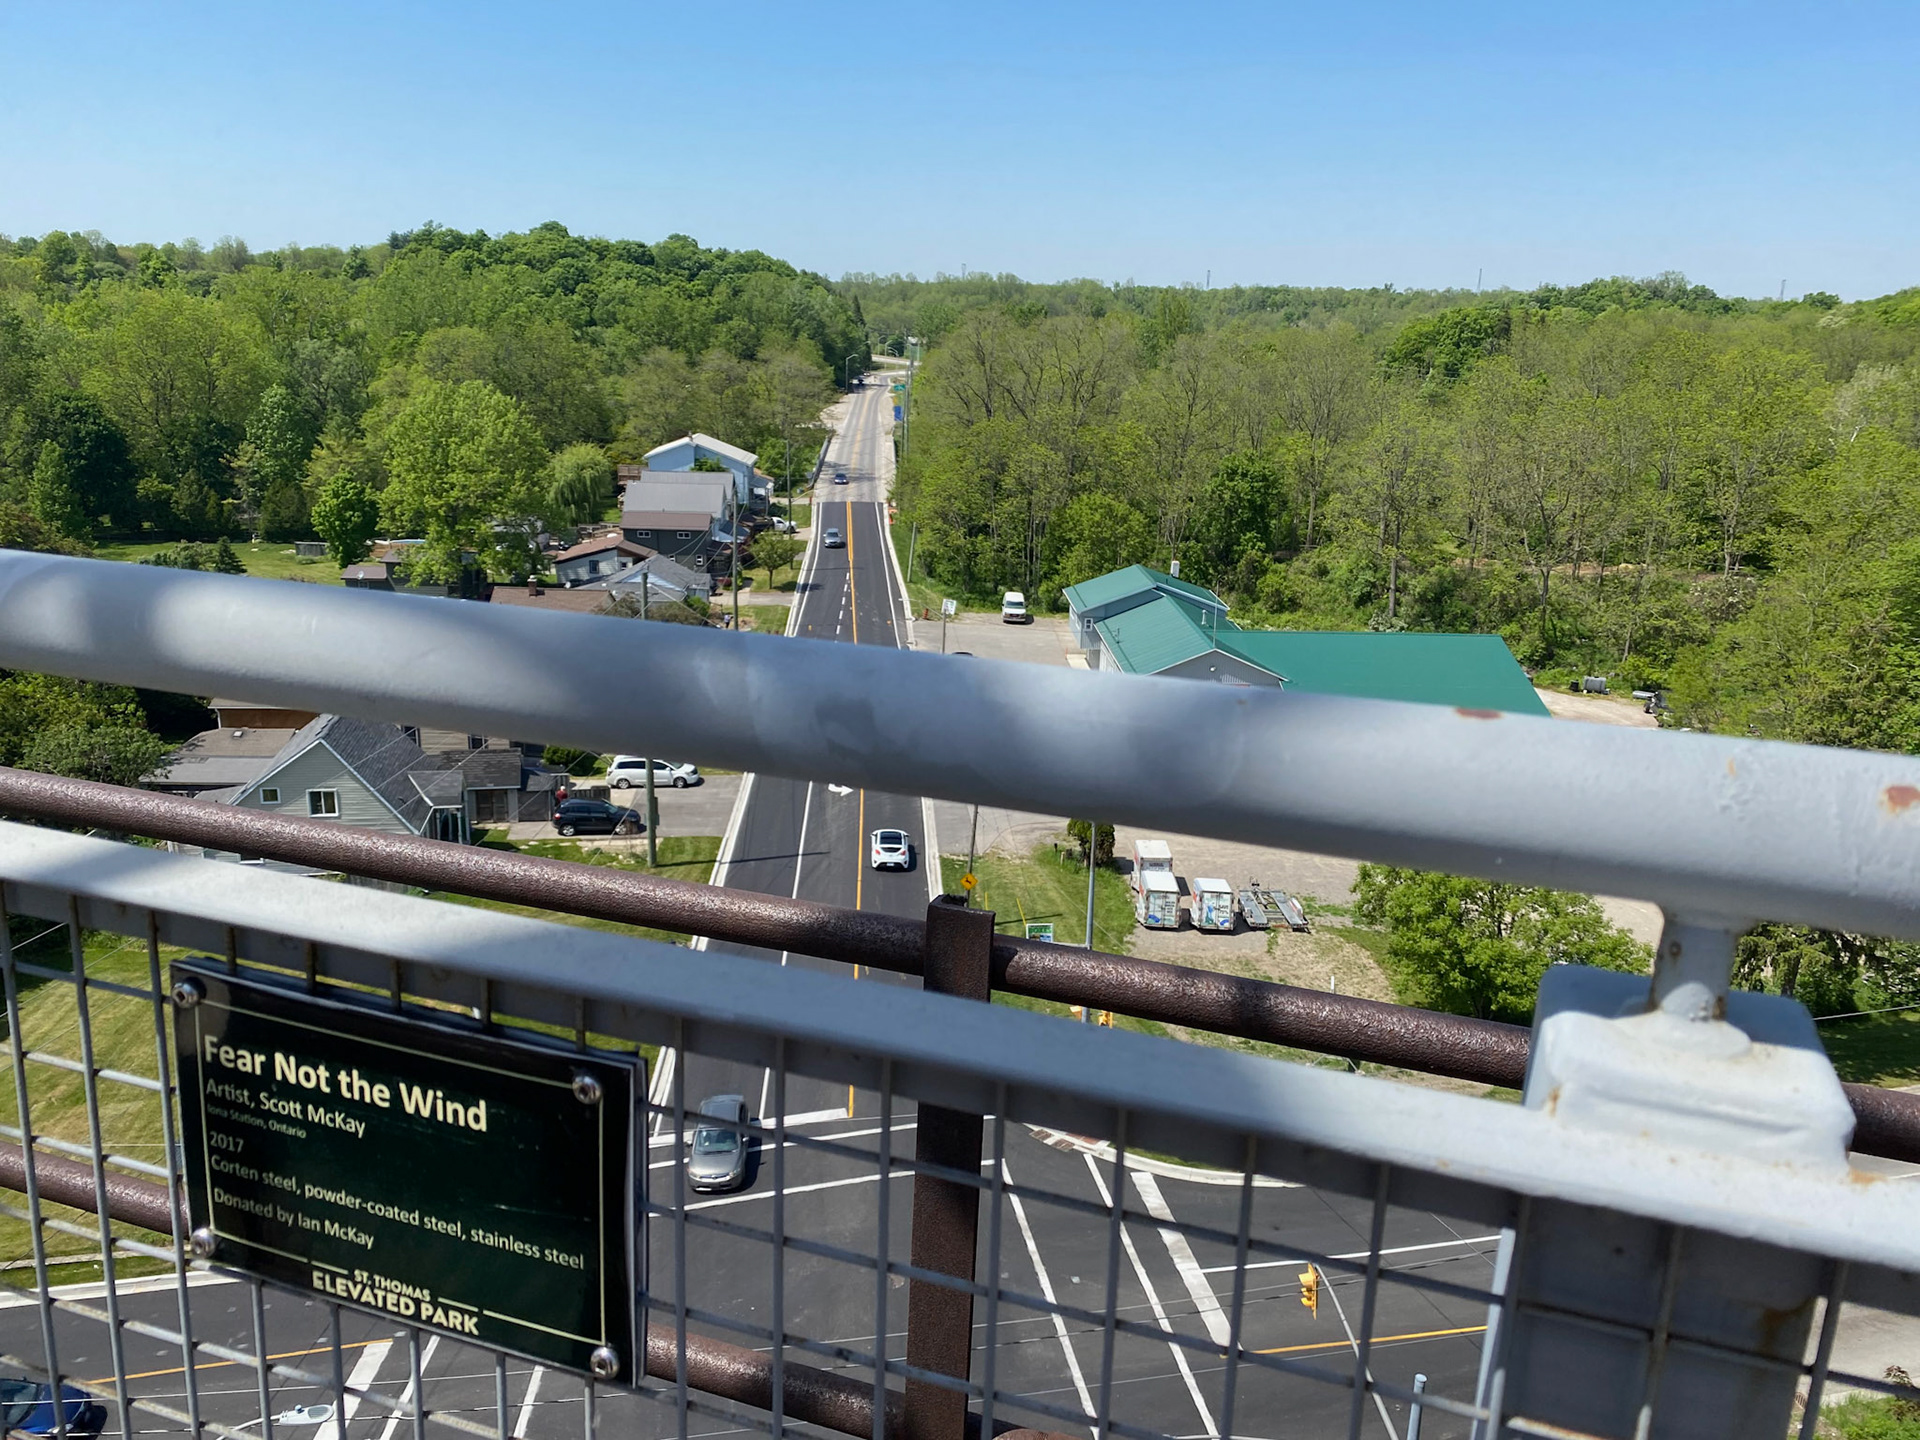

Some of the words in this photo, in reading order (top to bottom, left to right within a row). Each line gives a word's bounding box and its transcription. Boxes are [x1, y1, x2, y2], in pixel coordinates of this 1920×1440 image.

[204, 1035, 266, 1075] Fear
[274, 1052, 331, 1093] Not
[338, 1069, 390, 1108] the
[400, 1082, 487, 1132] Wind
[206, 1078, 256, 1108] Artist,
[260, 1091, 303, 1120] Scott
[308, 1104, 365, 1138] McKay
[207, 1103, 228, 1119] Iona
[229, 1108, 267, 1130] Station,
[269, 1119, 307, 1139] Ontario
[210, 1131, 244, 1153] 2017
[211, 1154, 258, 1181] Corten
[262, 1172, 301, 1195] steel,
[305, 1183, 419, 1226] powder-coated
[424, 1216, 466, 1241] steel,
[471, 1228, 540, 1258] stainless
[545, 1248, 584, 1270] steel
[214, 1187, 273, 1218] Donated
[277, 1205, 294, 1227] by
[298, 1212, 321, 1232] Ian
[324, 1219, 374, 1250] McKay
[312, 1270, 416, 1316] ELEVATED
[420, 1302, 479, 1336] PARK
[354, 1269, 371, 1285] ST.
[373, 1274, 431, 1302] THOMAS
